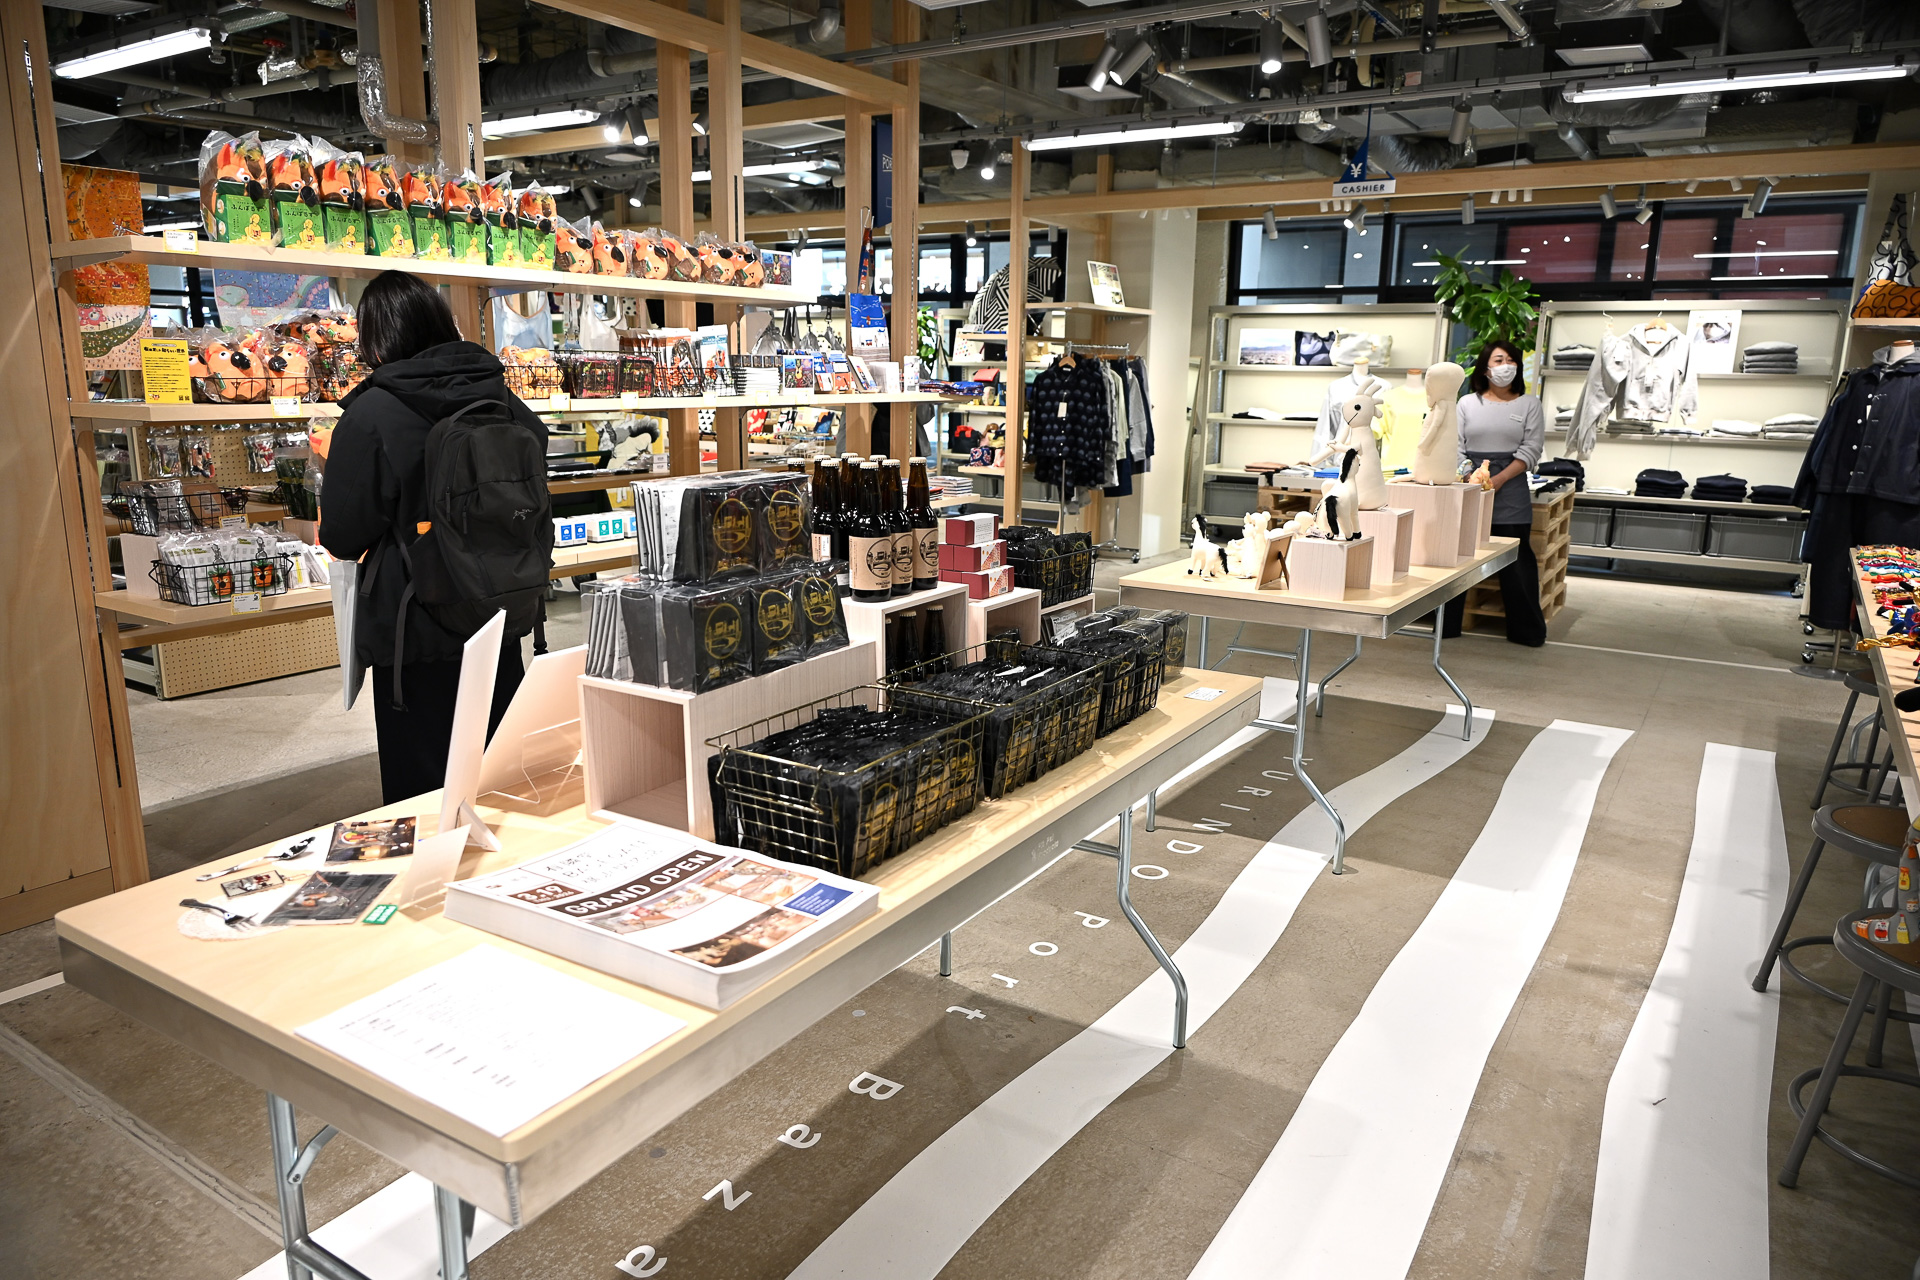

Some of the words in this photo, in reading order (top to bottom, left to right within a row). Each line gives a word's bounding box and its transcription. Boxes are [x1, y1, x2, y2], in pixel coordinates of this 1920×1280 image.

[1341, 183, 1385, 194] CASHIER
[517, 883, 563, 901] 3.19
[564, 883, 652, 914] GRAND
[649, 852, 715, 885] OPEN
[945, 911, 1110, 1021] Port
